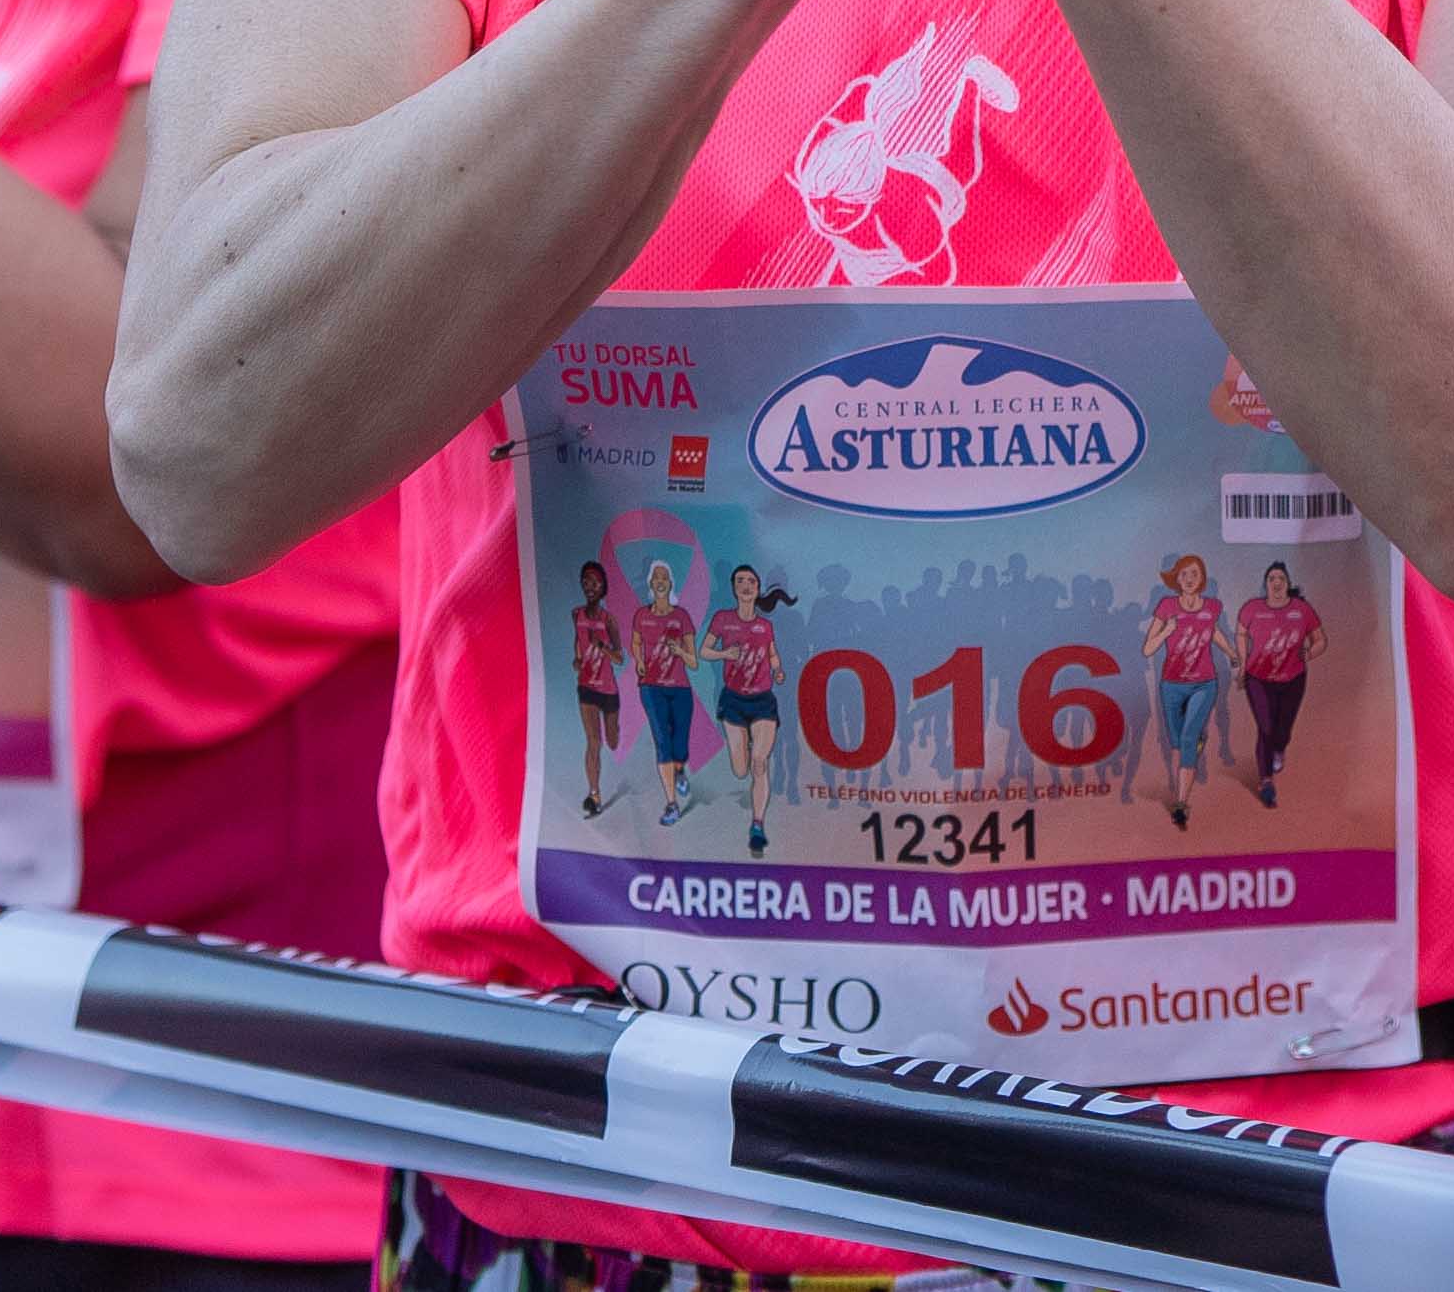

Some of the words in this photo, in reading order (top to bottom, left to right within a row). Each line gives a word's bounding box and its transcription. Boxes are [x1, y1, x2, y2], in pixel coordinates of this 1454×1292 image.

[554, 343, 587, 364] TU
[595, 344, 697, 367] DORSAL
[561, 368, 698, 410] SUMA
[834, 399, 962, 419] CENTRAL
[972, 395, 1103, 416] LECHERA
[578, 446, 655, 467] MADRID
[774, 404, 1117, 473] ASTURIANA
[796, 645, 1126, 773] 016
[807, 784, 896, 803] TELÉFONO
[900, 789, 999, 803] VIOLENCIA
[1005, 787, 1029, 800] DE
[1033, 782, 1112, 799] GÉNERO
[860, 809, 1037, 868] 12341
[629, 874, 810, 921] CARRERA
[825, 881, 874, 921] DE
[888, 884, 937, 927] LA
[949, 880, 1088, 928] MUJER
[1126, 869, 1297, 913] MADRID
[620, 960, 883, 1032] OYSHO
[1059, 973, 1315, 1032] Santander
